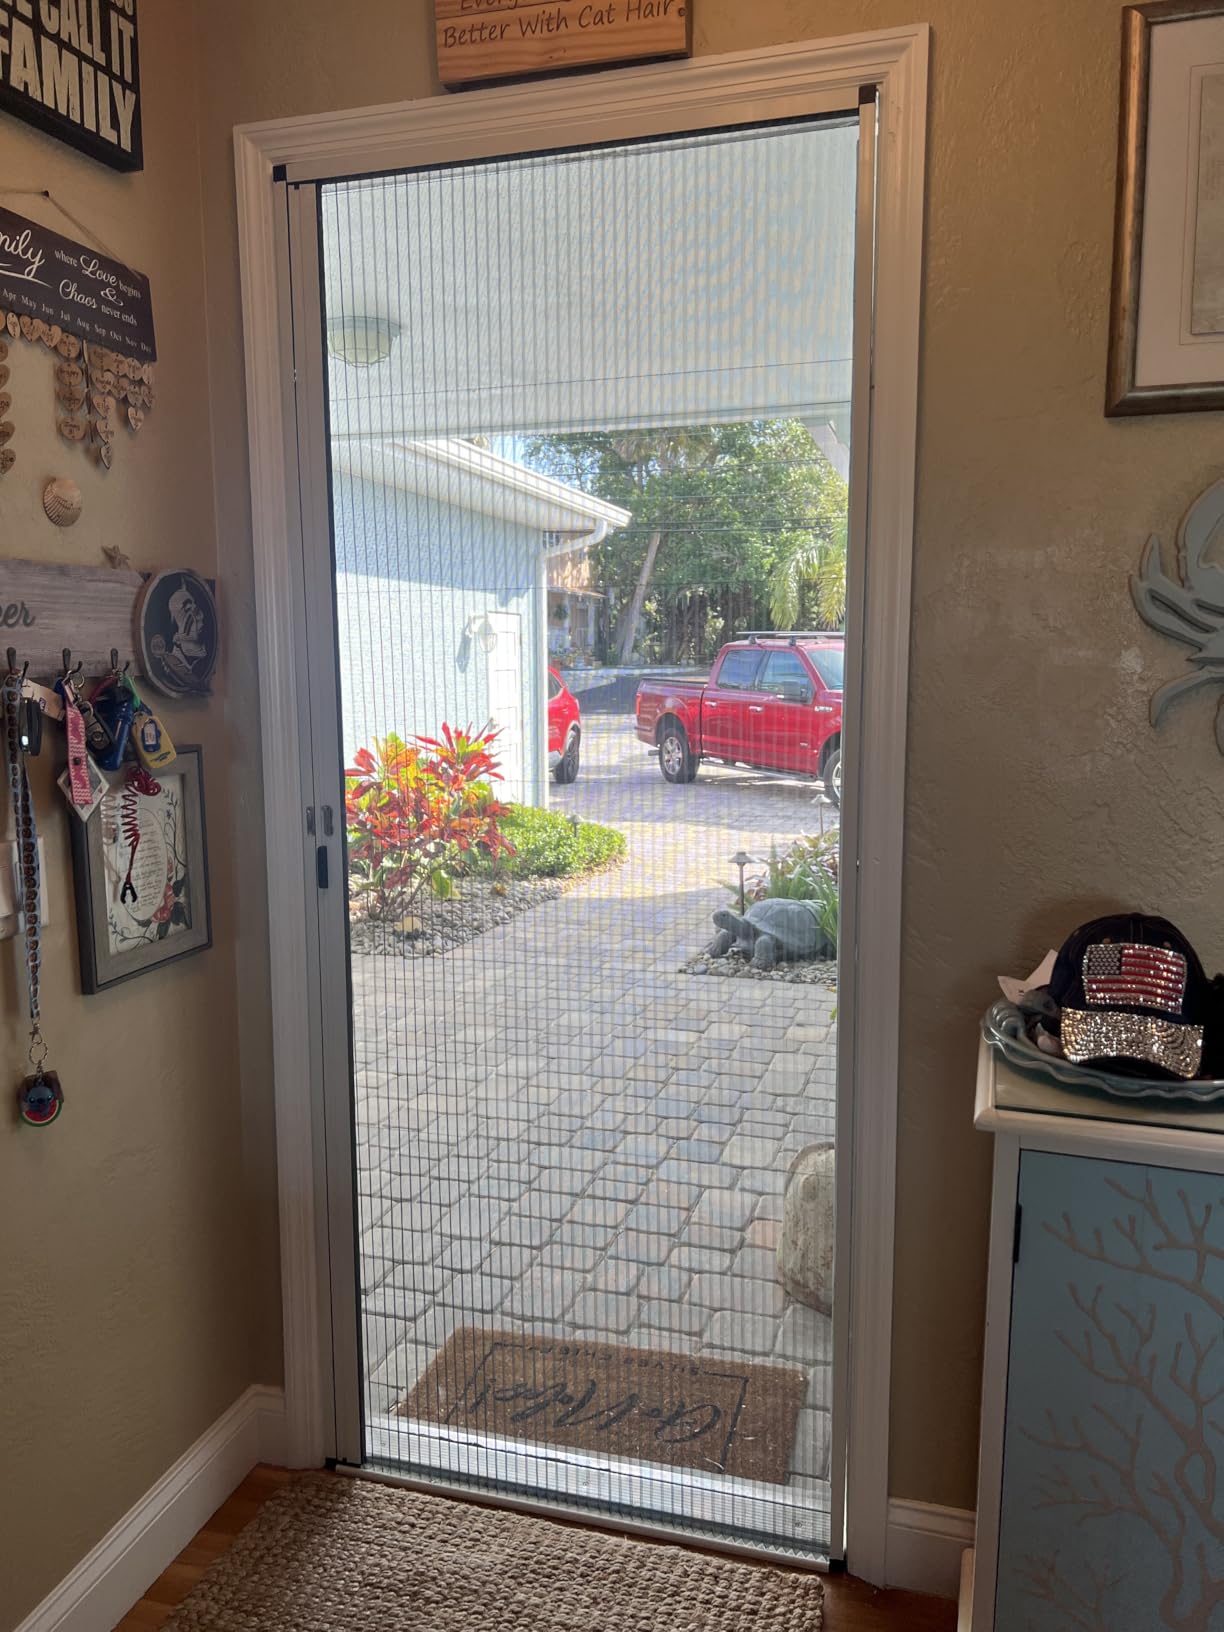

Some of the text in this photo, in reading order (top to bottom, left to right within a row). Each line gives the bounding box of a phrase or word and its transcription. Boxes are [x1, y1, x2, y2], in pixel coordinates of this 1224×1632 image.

[110, 9, 134, 83] IT
[443, 22, 510, 48] Better
[518, 7, 570, 38] With
[578, 4, 616, 30] Cat
[54, 249, 142, 298] where Love begins
[100, 287, 124, 306] &
[2, 288, 16, 301] Apr
[21, 295, 37, 311] May
[42, 303, 54, 315] Jun
[76, 317, 90, 331] Aug
[94, 324, 106, 337] Sep
[110, 330, 122, 342] Oct
[59, 279, 138, 327] Chaos never ends
[0, 600, 36, 628] er
